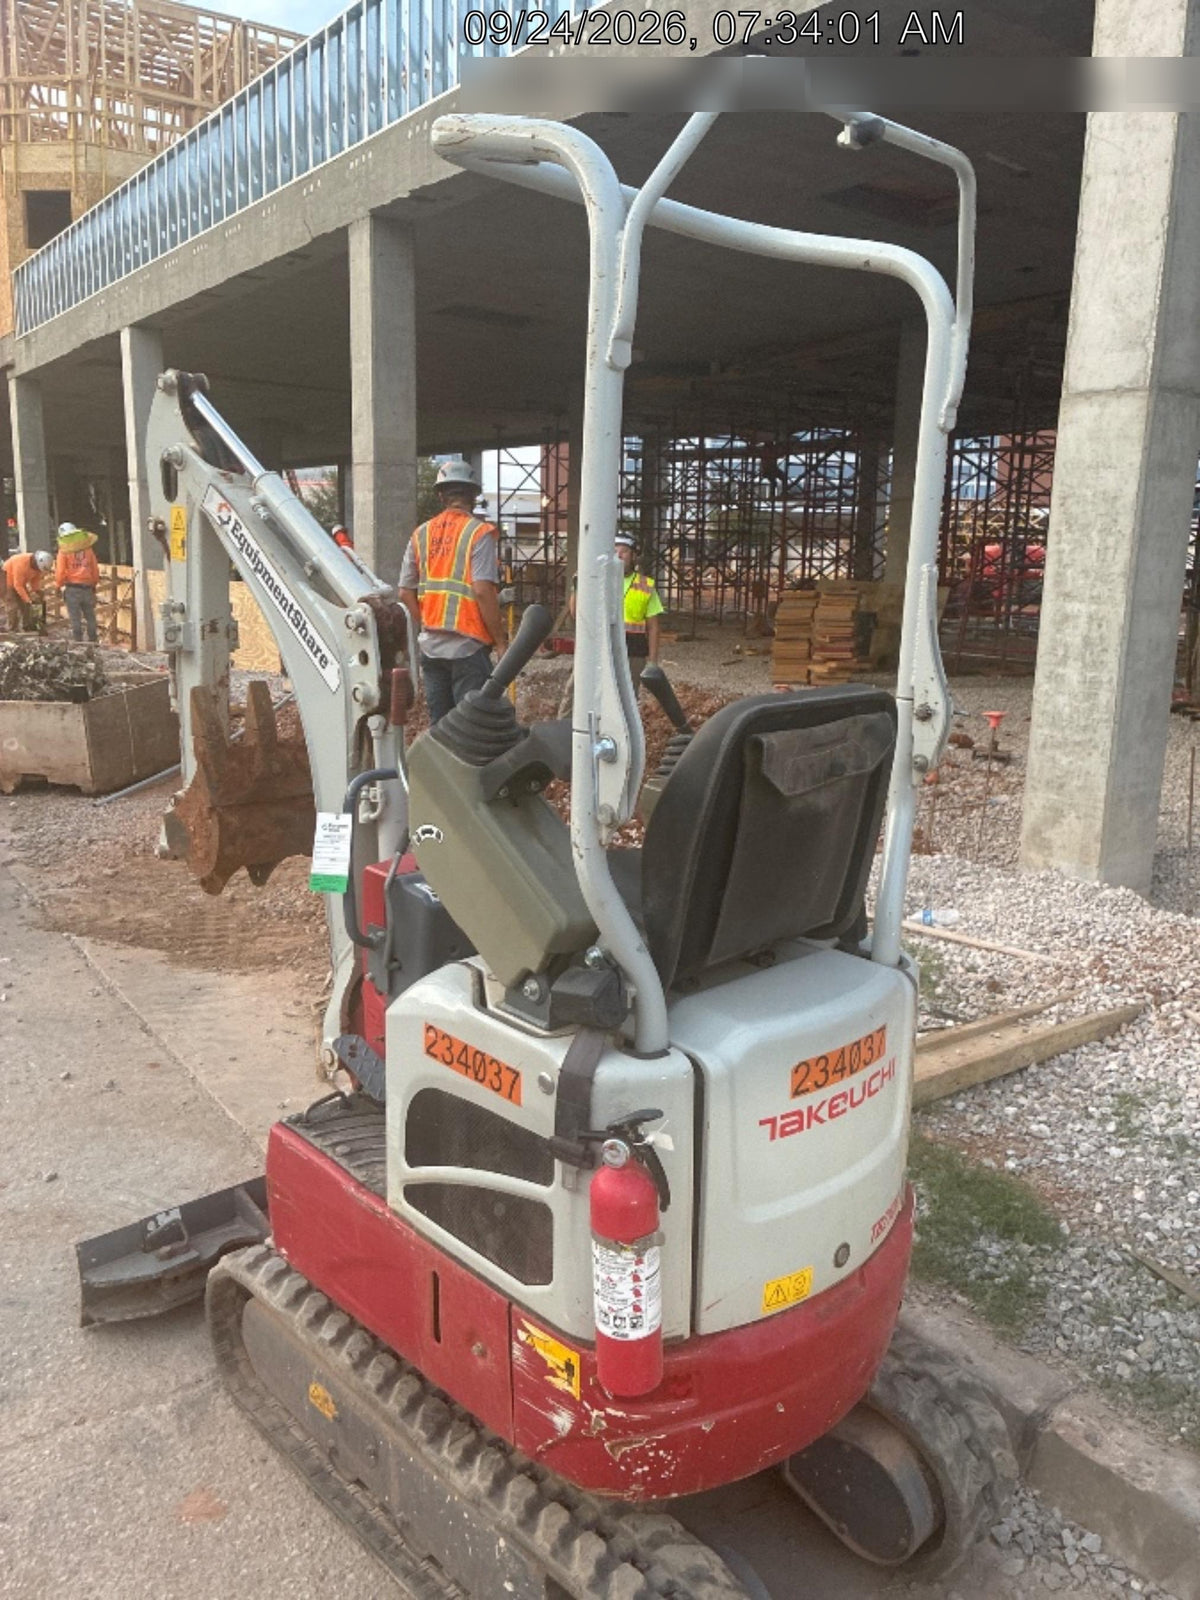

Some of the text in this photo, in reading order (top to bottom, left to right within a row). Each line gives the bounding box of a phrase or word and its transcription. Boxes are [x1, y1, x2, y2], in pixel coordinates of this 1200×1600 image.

[230, 520, 330, 670] EquipmentShare
[425, 1024, 521, 1100] 234037
[758, 1055, 897, 1142] TAKEUCHI
[791, 1023, 887, 1099] 234037
